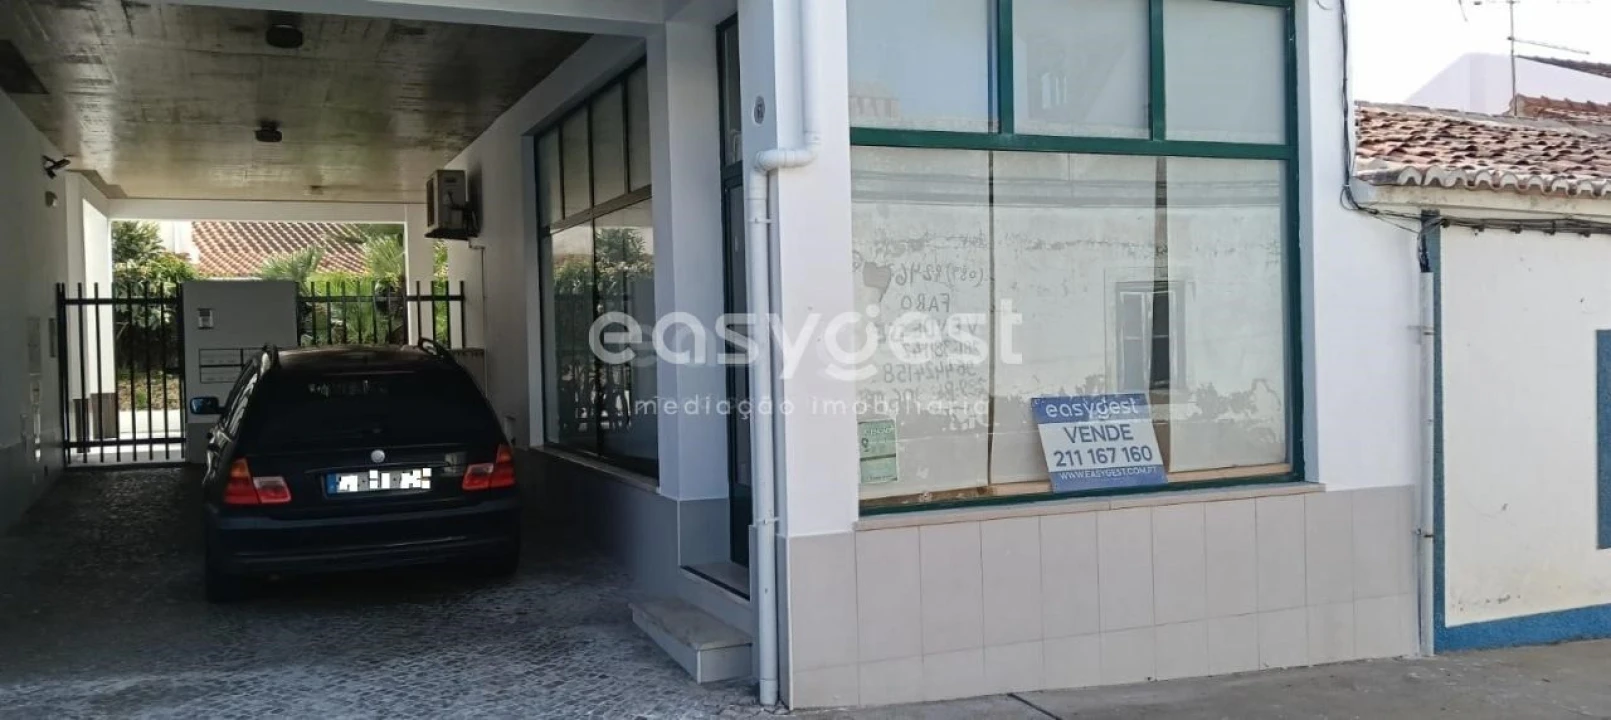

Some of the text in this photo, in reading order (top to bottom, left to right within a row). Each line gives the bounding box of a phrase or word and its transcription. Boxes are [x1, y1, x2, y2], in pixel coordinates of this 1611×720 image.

[1045, 397, 1139, 420] easygest
[1063, 424, 1134, 443] VENDE
[1053, 444, 1153, 468] 211 167 160
